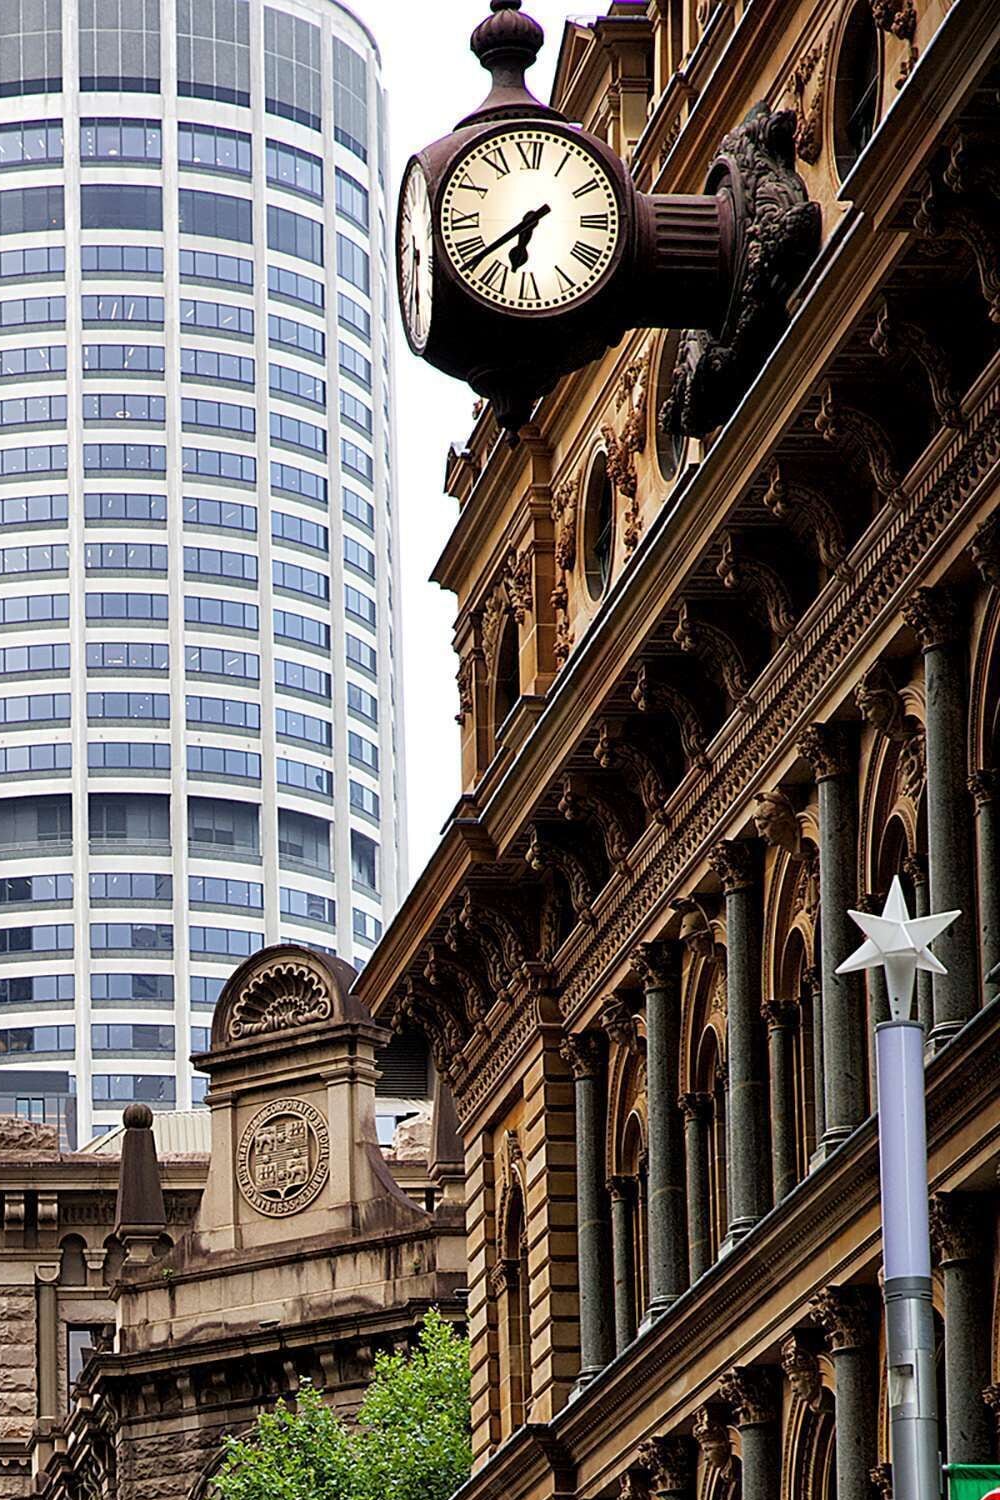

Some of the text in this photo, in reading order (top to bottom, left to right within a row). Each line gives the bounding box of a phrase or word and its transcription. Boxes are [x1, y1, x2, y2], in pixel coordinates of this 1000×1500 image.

[481, 147, 510, 180] XI
[515, 141, 544, 170] XII
[554, 152, 571, 177] I
[458, 173, 488, 199] X
[572, 178, 600, 199] II
[451, 207, 479, 231] IX
[580, 213, 608, 230] III
[570, 241, 603, 271] IIII
[479, 259, 508, 294] VII
[518, 272, 541, 300] VI
[554, 265, 576, 293] V
[318, 1129, 329, 1160] ROYAL
[298, 1161, 327, 1203] CHARTER
